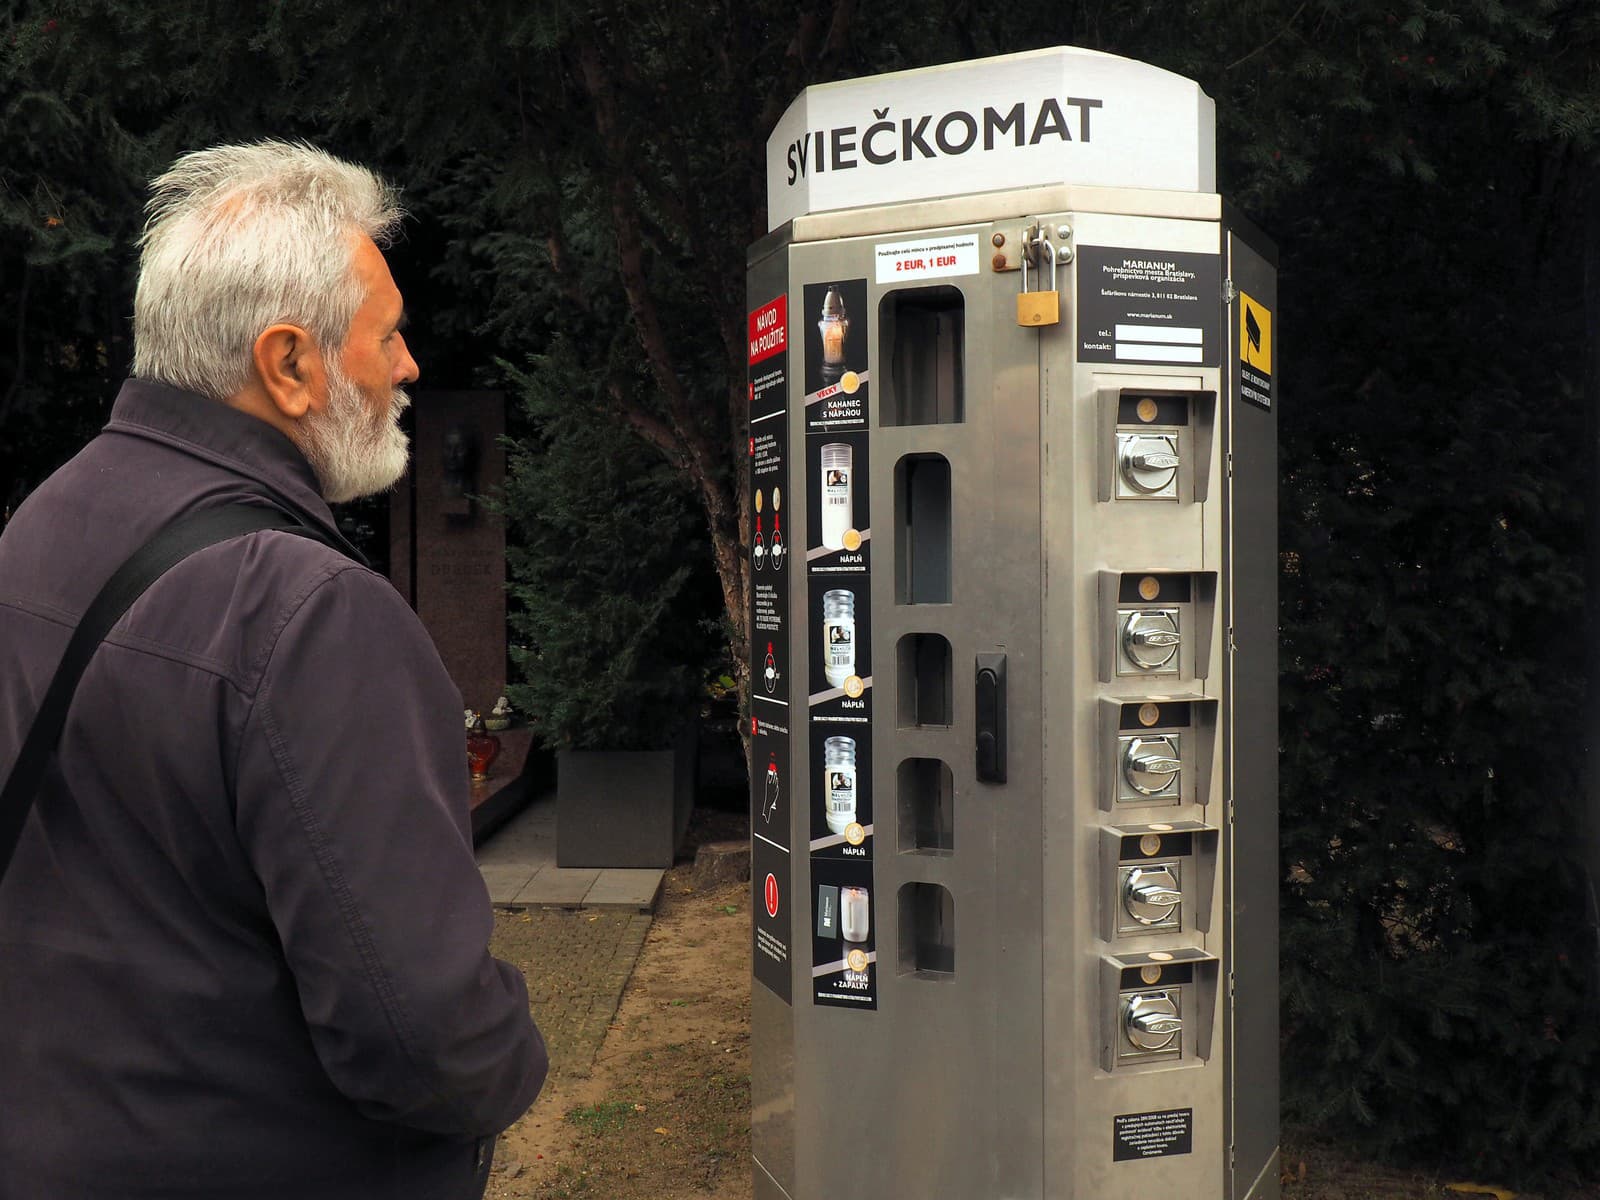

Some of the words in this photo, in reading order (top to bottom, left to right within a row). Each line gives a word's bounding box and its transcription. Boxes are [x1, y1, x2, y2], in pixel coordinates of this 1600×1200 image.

[787, 97, 1103, 187] SVIEČKOMAT
[896, 261, 902, 272] 2
[904, 258, 926, 270] EUR,
[929, 258, 933, 267] 1
[937, 255, 957, 267] EUR
[1123, 259, 1175, 271] MARIANUM
[757, 308, 777, 332] NÁVOD
[750, 339, 759, 357] NA
[759, 326, 785, 353] POUŽITIE
[827, 399, 861, 409] KAHANEC
[823, 410, 827, 418] S
[829, 408, 861, 418] NÁPLŇOU
[840, 553, 862, 563] NÁPLŇ
[843, 847, 866, 857] NÁPLŇ
